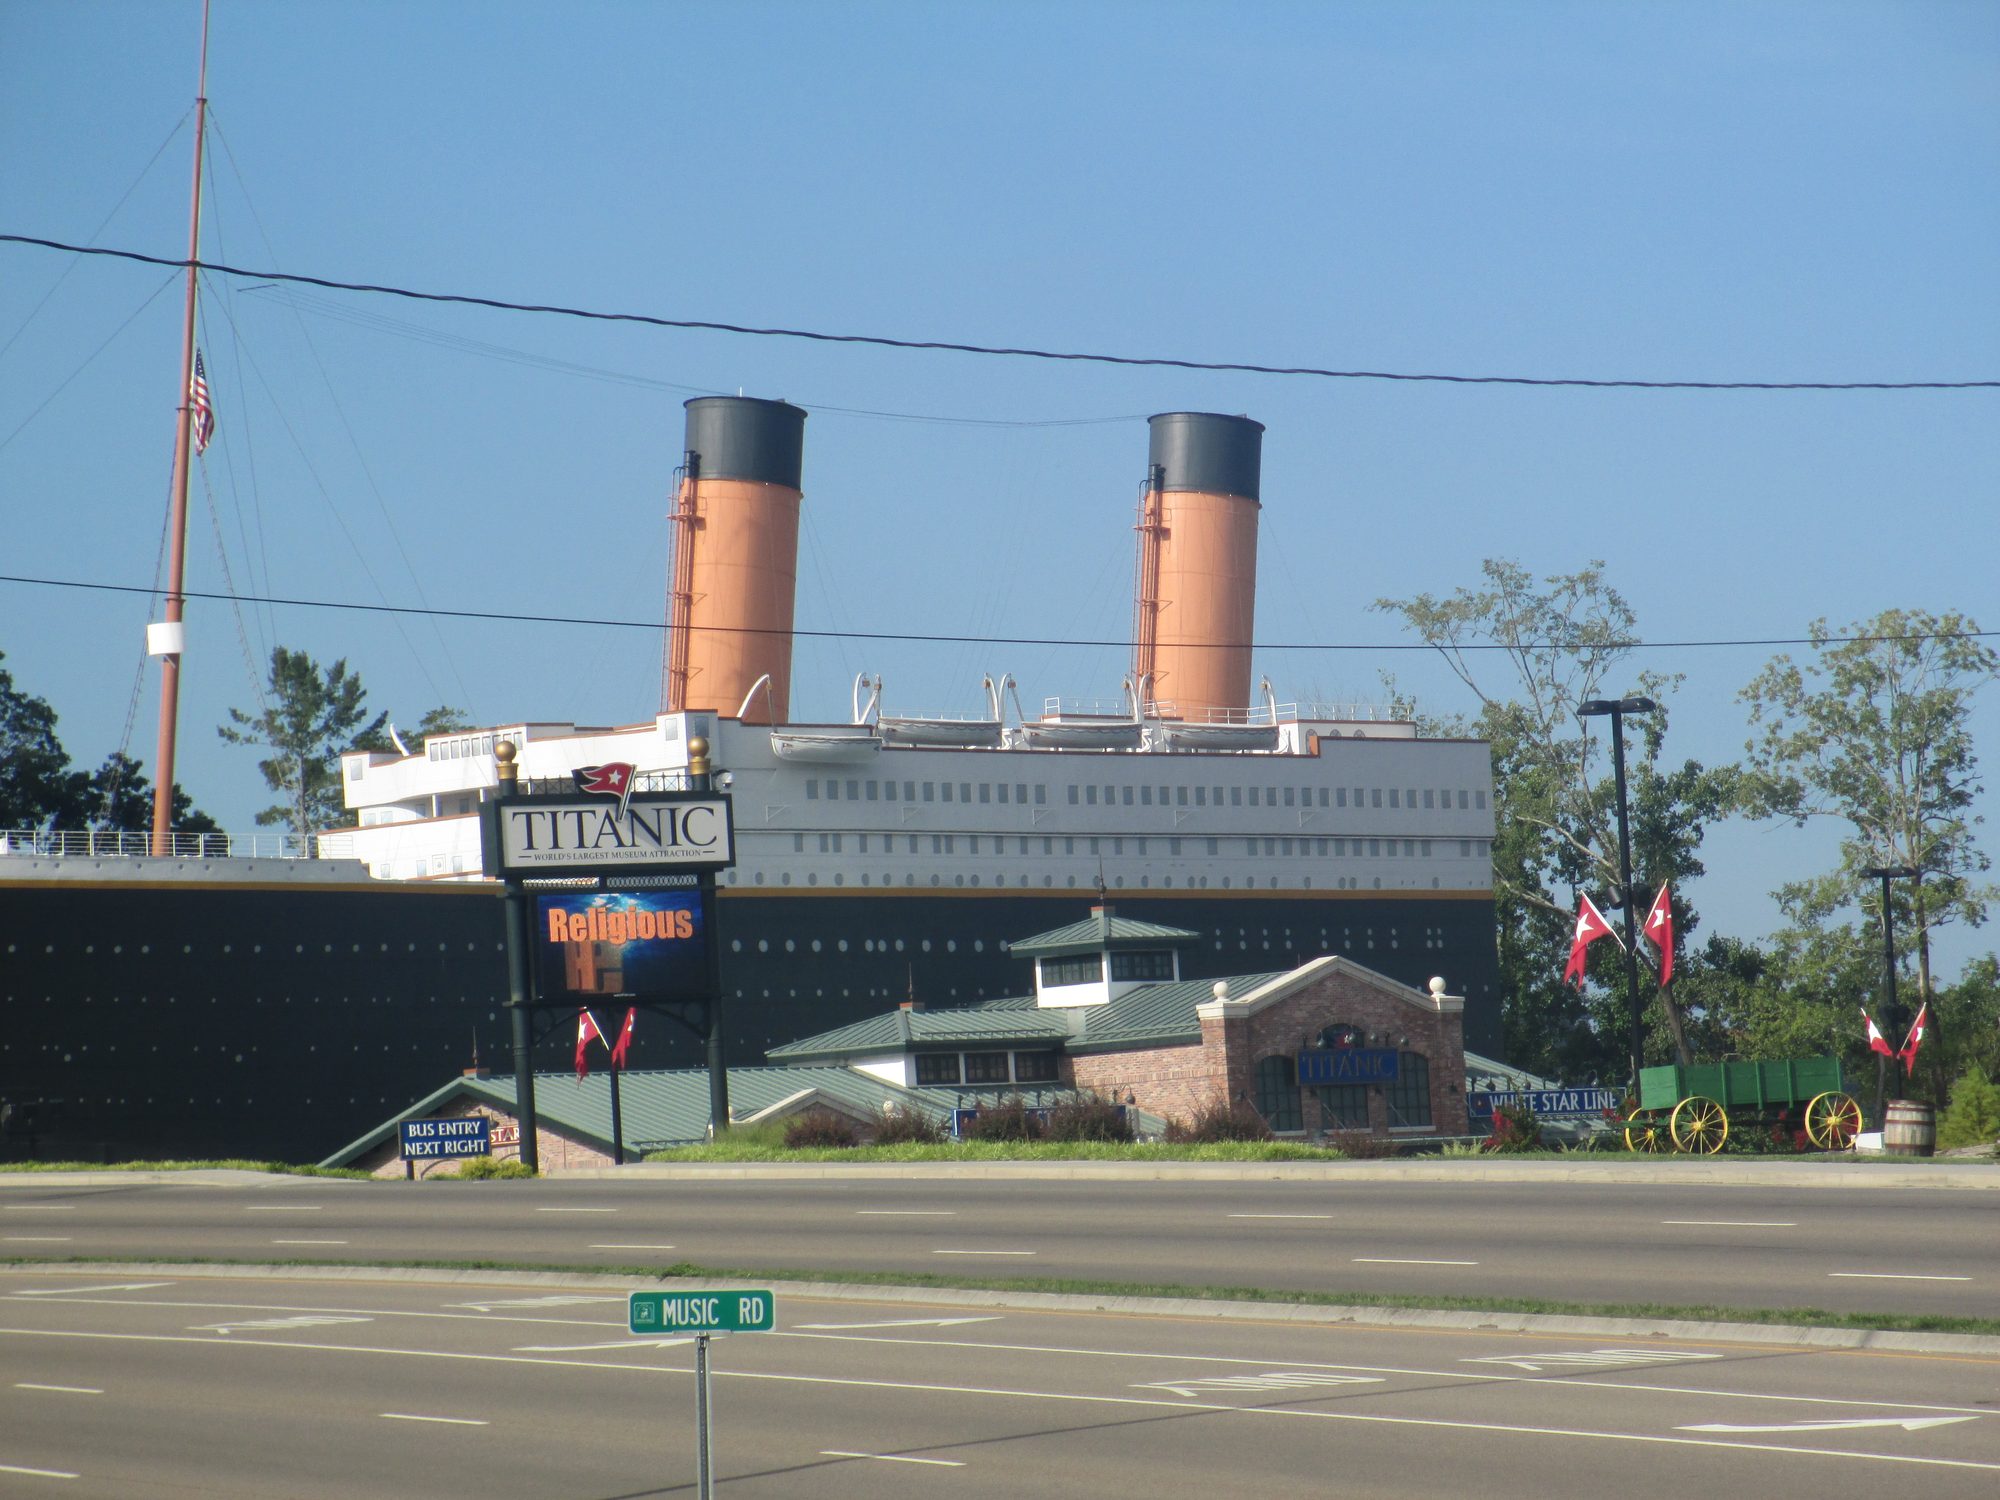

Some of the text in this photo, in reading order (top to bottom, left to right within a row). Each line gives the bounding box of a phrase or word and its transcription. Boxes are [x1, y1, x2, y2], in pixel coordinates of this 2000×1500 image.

[512, 806, 717, 851] TITANIC
[534, 849, 701, 861] WORLD'S LARGEST MUSEUM ATTRACTION
[548, 906, 693, 945] Religious
[1301, 1055, 1394, 1079] TITANIC
[1542, 1093, 1580, 1111] STAR
[408, 1121, 480, 1137] BUS ENTRY
[404, 1139, 487, 1156] NEXT RIGHT
[662, 1297, 764, 1326] MUSIC RD
